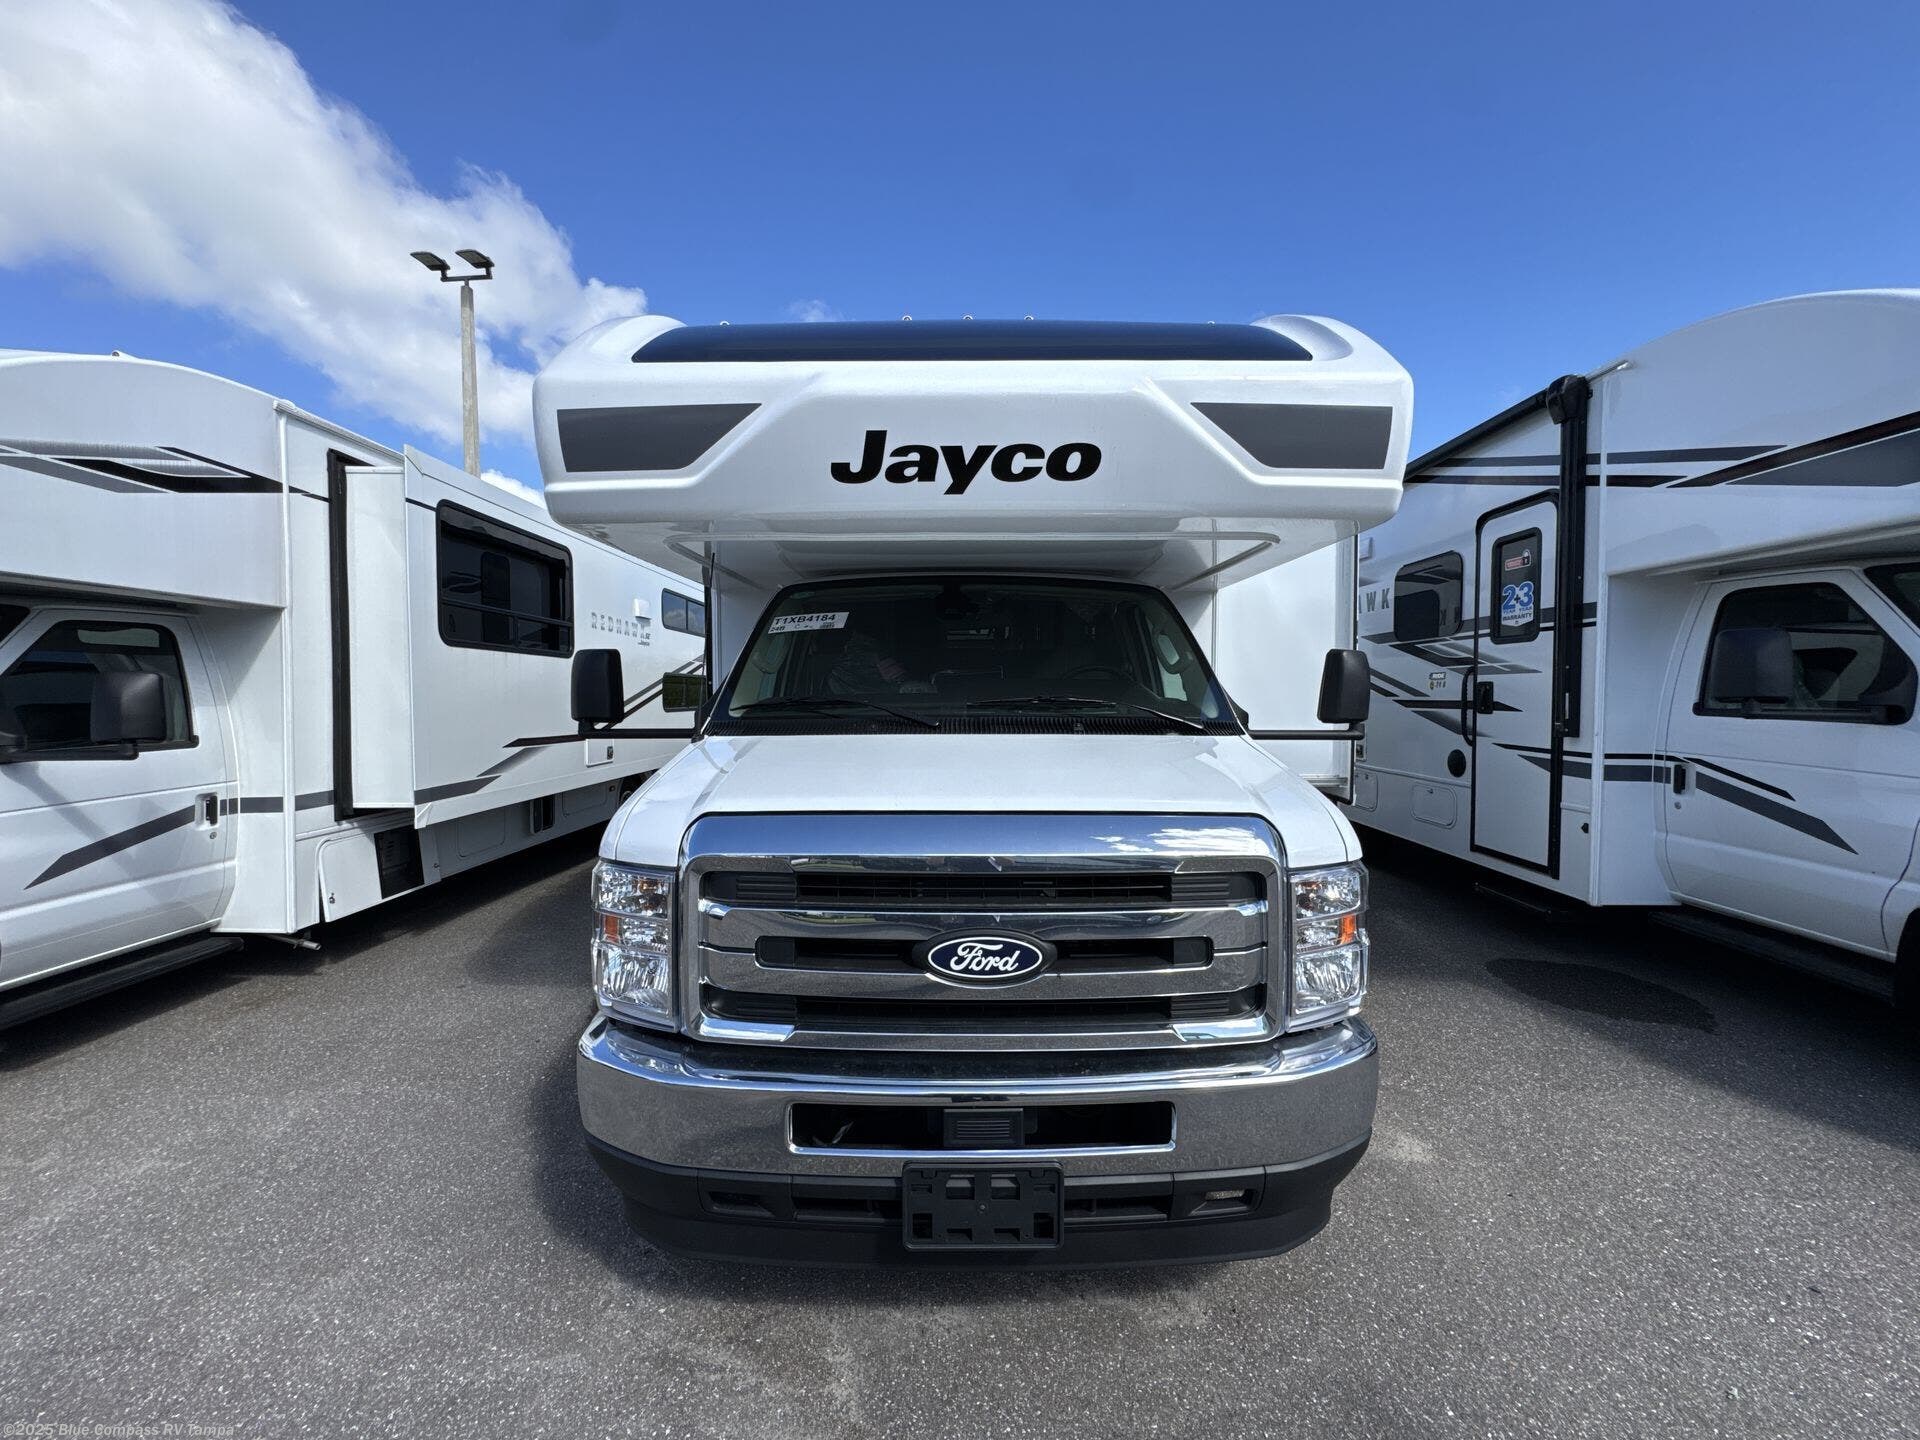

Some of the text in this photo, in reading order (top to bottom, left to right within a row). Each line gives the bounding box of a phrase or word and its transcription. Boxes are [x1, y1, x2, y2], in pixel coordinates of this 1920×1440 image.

[831, 430, 1102, 495] Jayco
[775, 614, 836, 625] T1XB4184
[949, 942, 1021, 971] Ford
